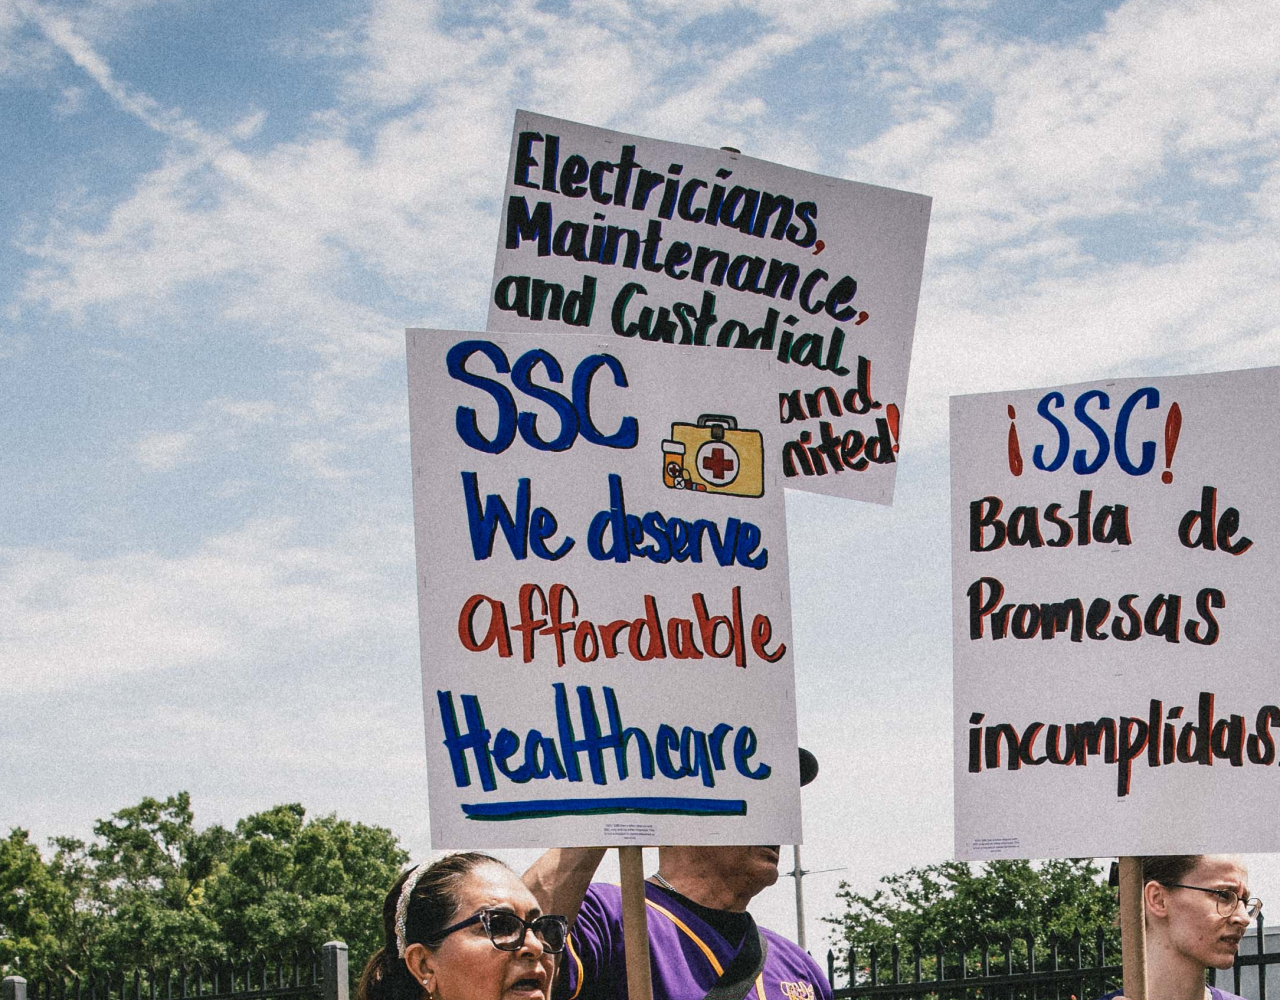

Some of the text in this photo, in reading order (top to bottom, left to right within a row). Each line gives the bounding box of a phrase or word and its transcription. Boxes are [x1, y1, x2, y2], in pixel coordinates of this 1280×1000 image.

[513, 131, 826, 257] Electricians,
[493, 274, 598, 327] and
[504, 195, 870, 326] Maintenance,
[445, 339, 639, 454] SSC
[782, 402, 900, 478] nited!
[460, 471, 768, 570] We deserve
[969, 486, 1254, 556] Basta de
[457, 582, 787, 668] affordable
[966, 576, 1226, 646] Promesas
[437, 682, 772, 792] Healthcare
